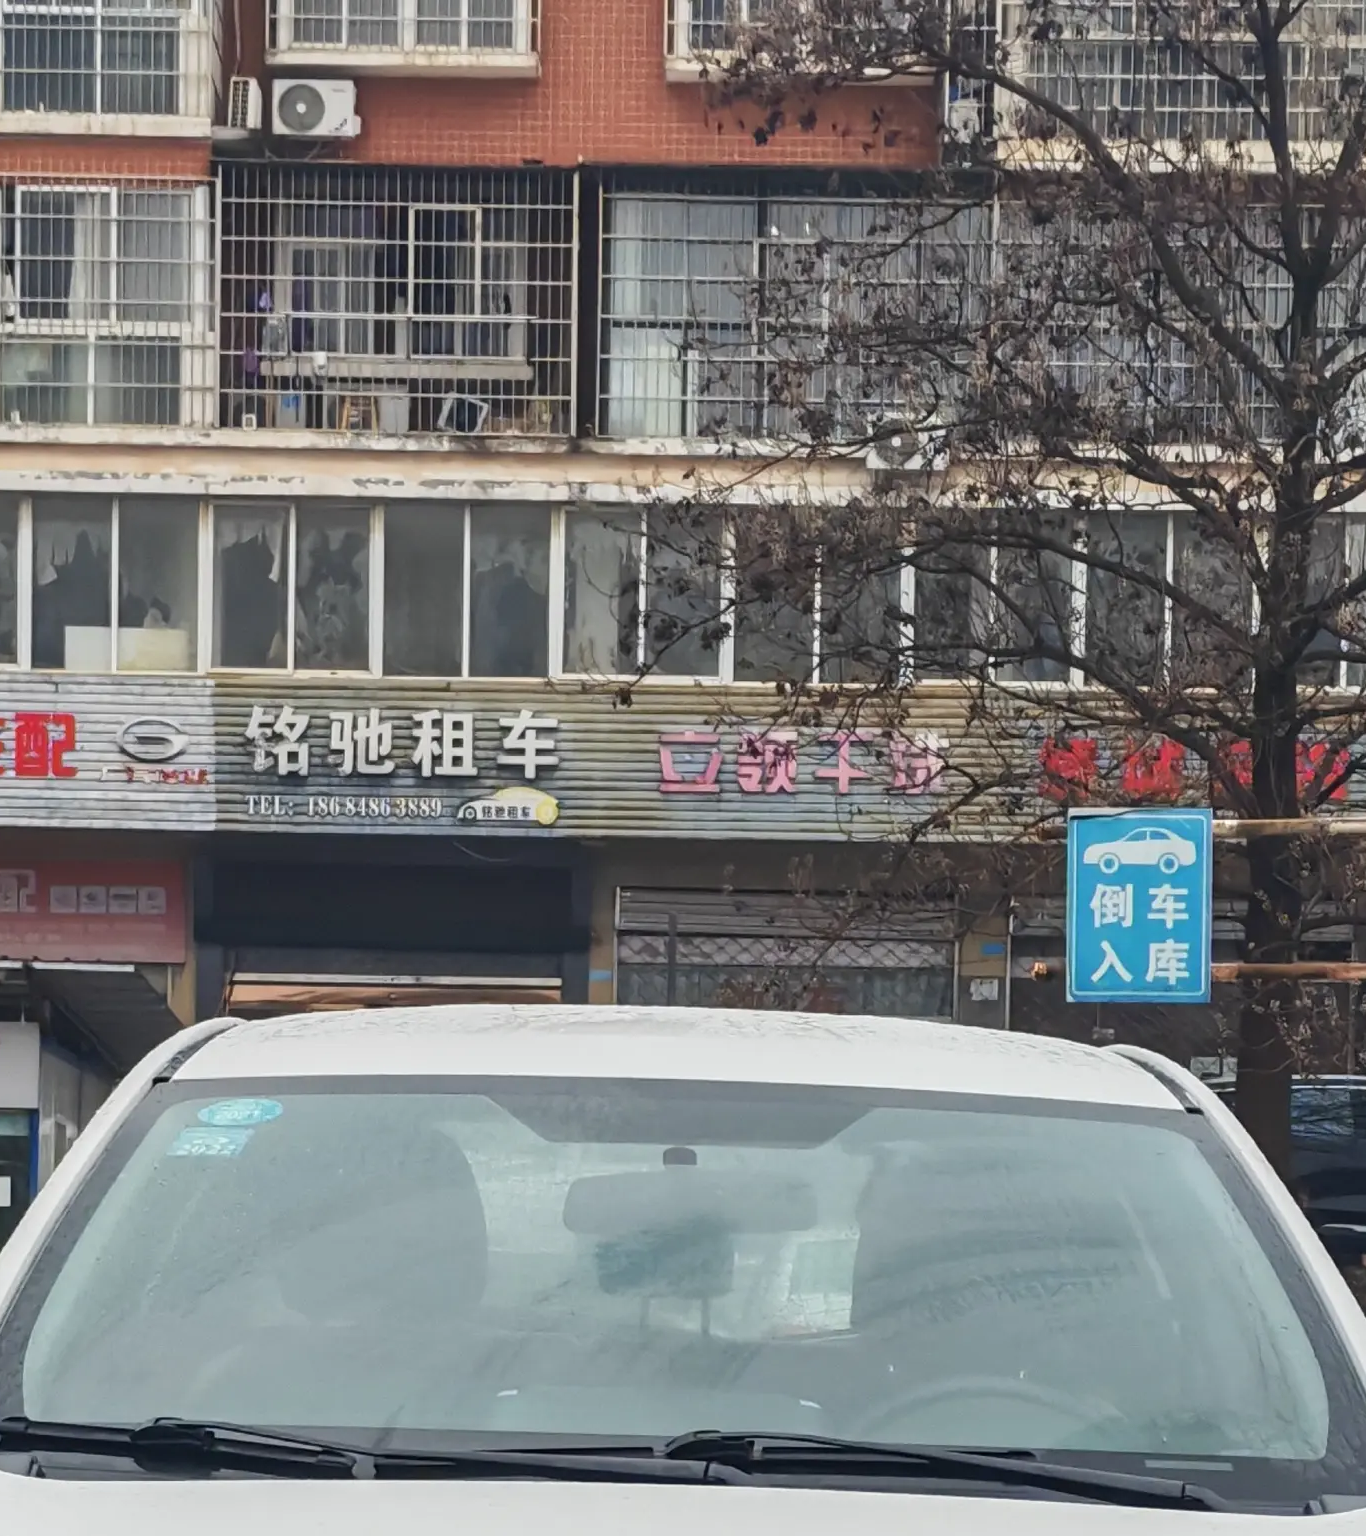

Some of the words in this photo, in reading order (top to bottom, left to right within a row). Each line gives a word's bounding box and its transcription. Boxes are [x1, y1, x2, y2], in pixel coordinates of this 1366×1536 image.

[244, 705, 559, 778] 铭驰租车
[1090, 884, 1189, 930] 倒车
[1090, 942, 1190, 987] 入库
